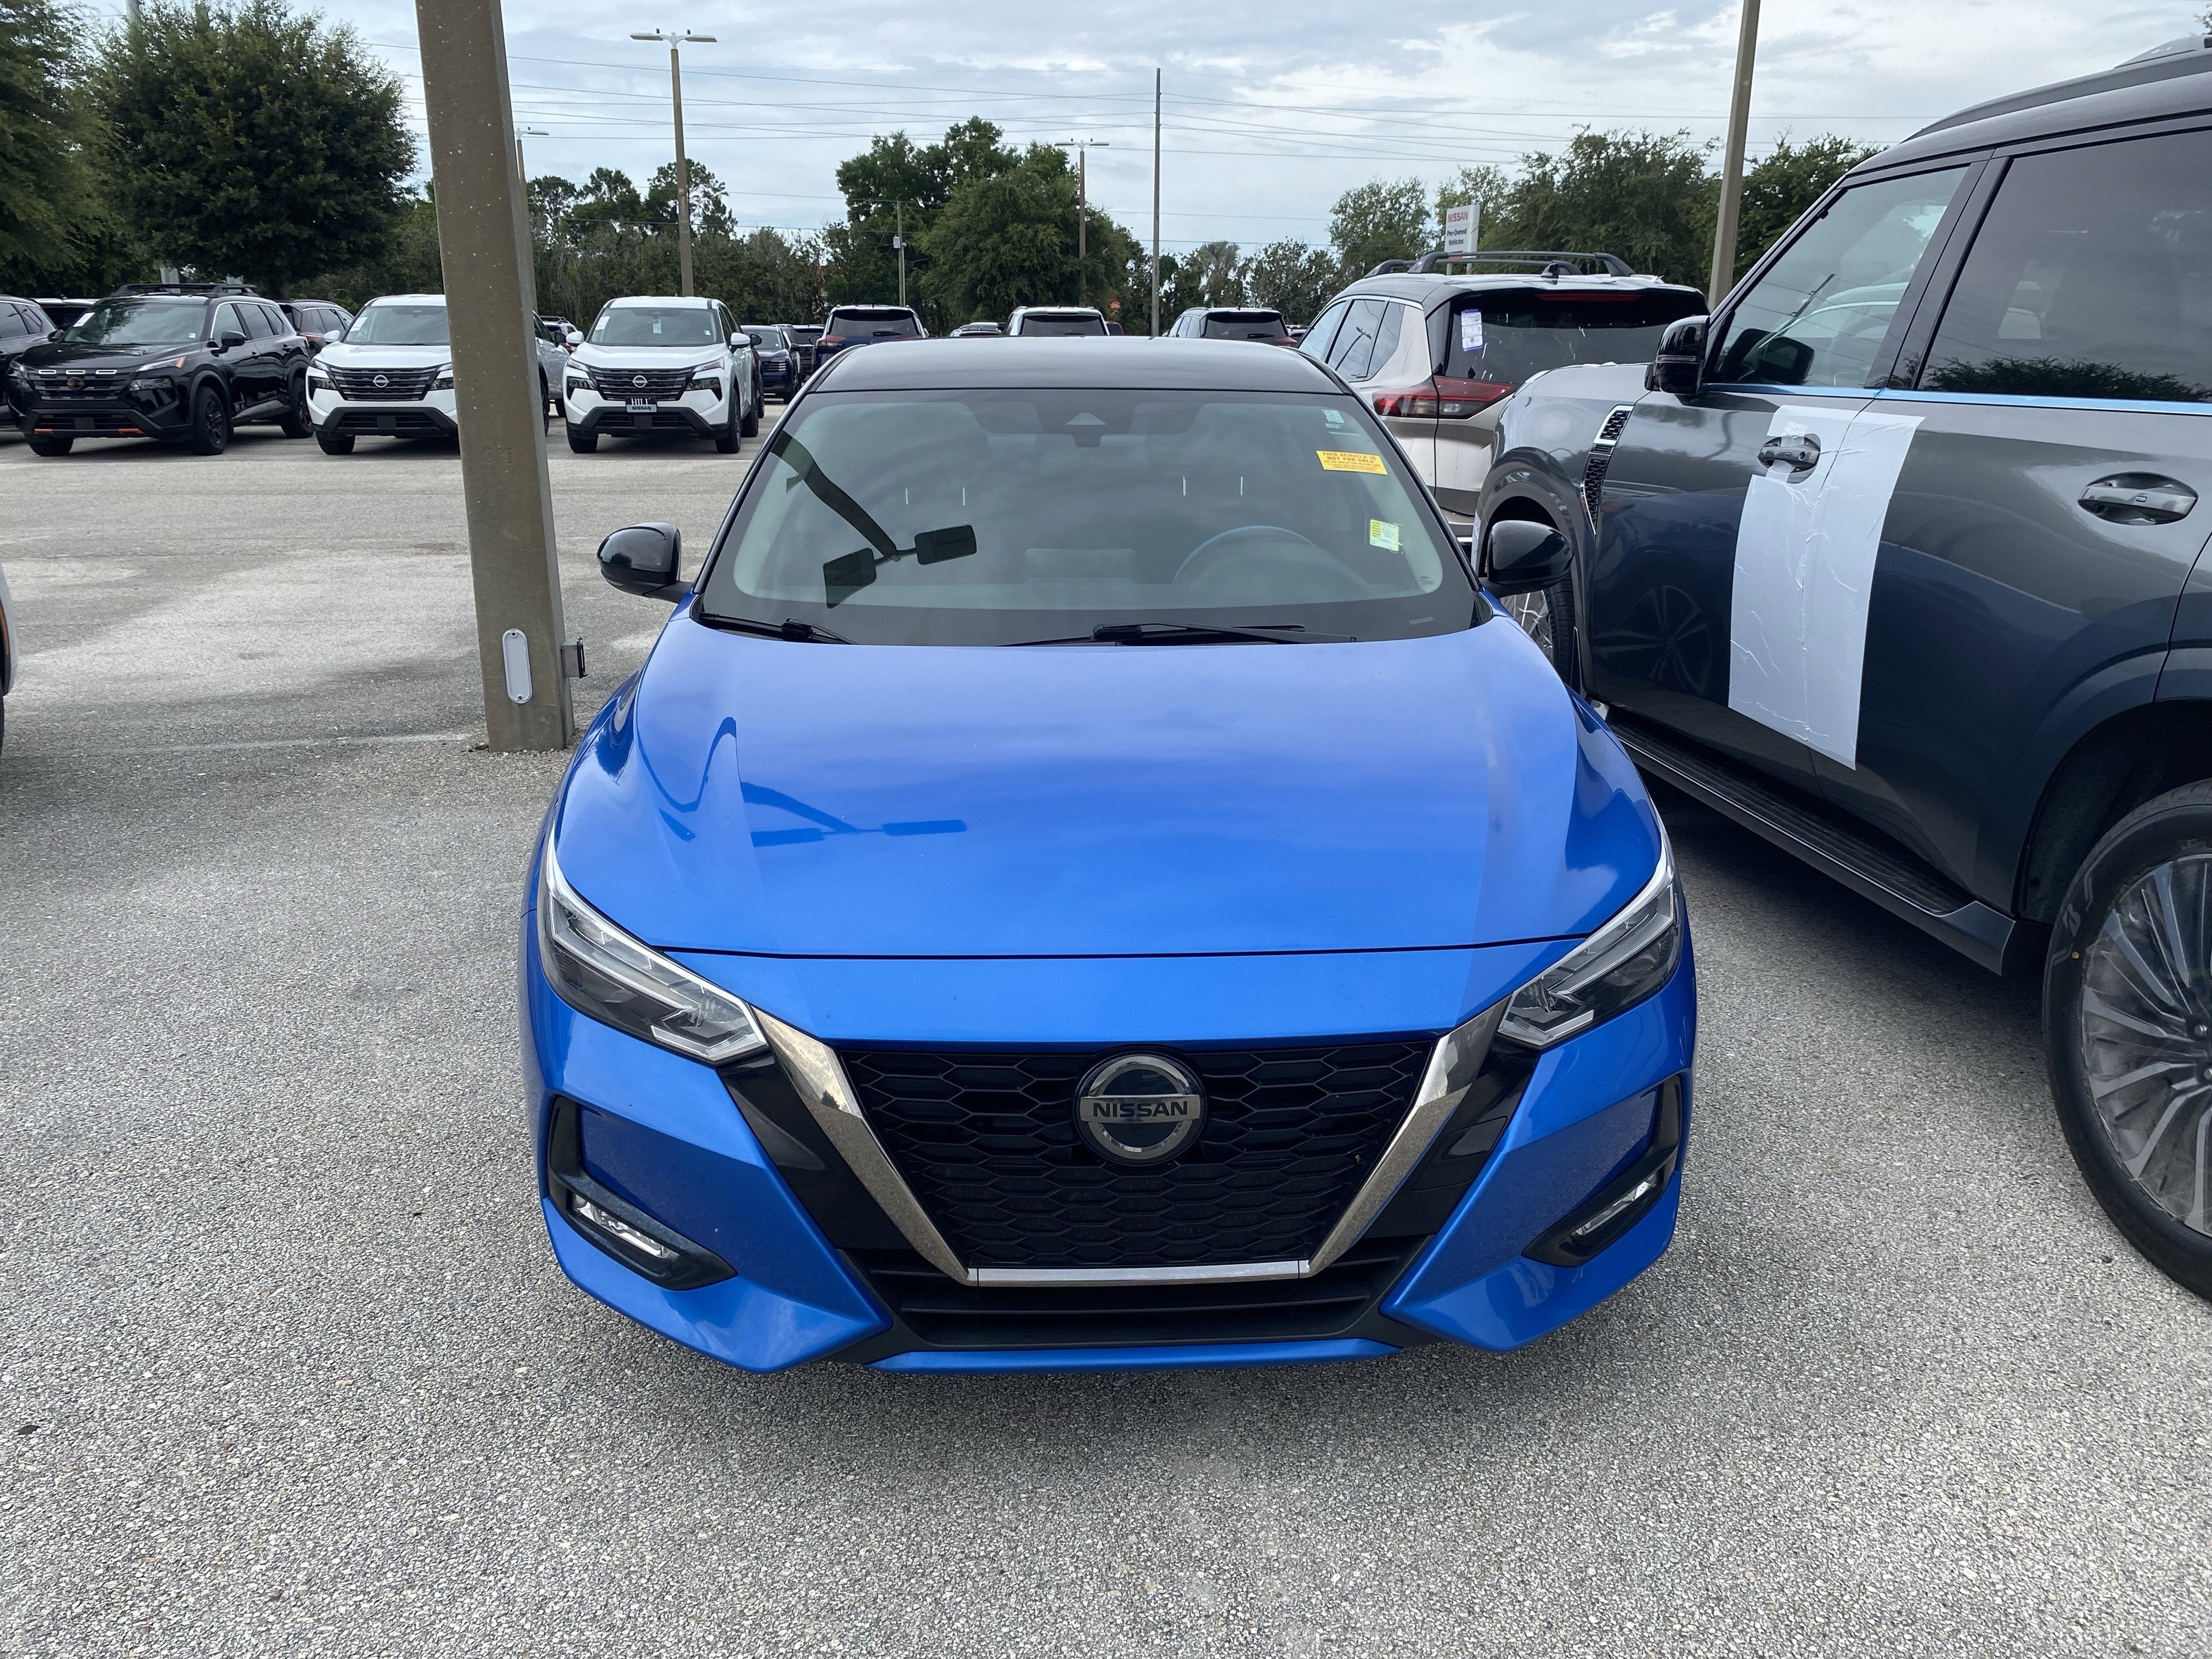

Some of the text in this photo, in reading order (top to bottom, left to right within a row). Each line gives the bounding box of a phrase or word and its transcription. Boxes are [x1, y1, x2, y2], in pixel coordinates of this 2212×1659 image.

[1448, 211, 1469, 223] NISSAN
[1447, 228, 1467, 236] Pre-Owned
[631, 398, 651, 406] HILL
[1093, 1101, 1188, 1118] NISSAN
